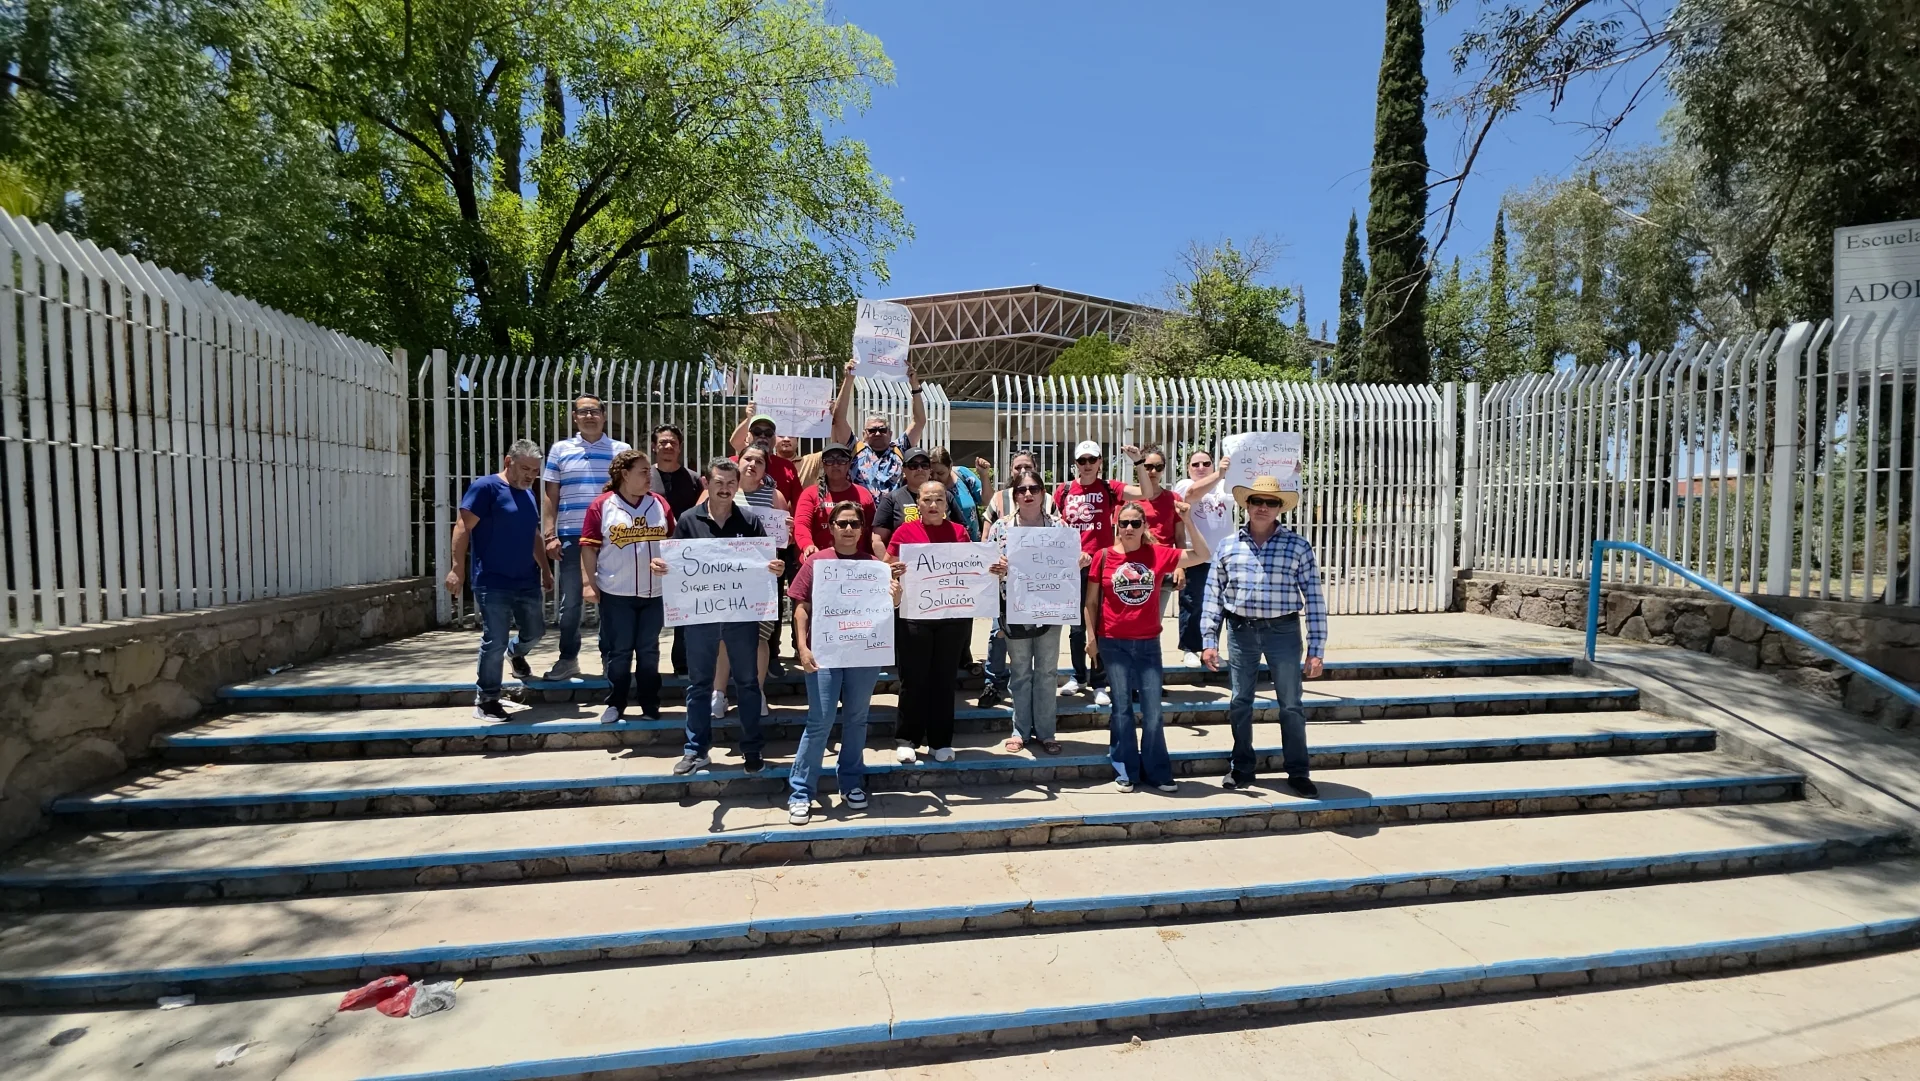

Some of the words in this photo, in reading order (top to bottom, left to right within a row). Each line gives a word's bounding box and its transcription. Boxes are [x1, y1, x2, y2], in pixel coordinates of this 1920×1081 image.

[861, 303, 910, 326] Abrogación
[874, 325, 906, 338] TOTAL
[872, 345, 885, 355] del
[760, 396, 799, 405] MENTISTE
[1257, 444, 1268, 452] un
[1240, 454, 1253, 464] de
[1258, 453, 1293, 467] Seguridad
[1244, 467, 1271, 480] Social
[634, 516, 646, 527] 60
[1096, 522, 1102, 530] 3
[1020, 535, 1038, 548] El
[682, 546, 748, 577] SONORA
[916, 553, 985, 575] Abrogación
[1032, 552, 1043, 563] El
[1046, 555, 1065, 566] Paro
[823, 566, 839, 580] Si
[846, 568, 878, 580] Puedes
[713, 583, 726, 591] EN
[732, 582, 743, 590] LA
[938, 578, 950, 586] es
[955, 576, 965, 586] la
[840, 584, 863, 594] Leer
[1027, 582, 1061, 592] ESTADO
[918, 589, 976, 610] Solución
[695, 596, 748, 615] LUCHA
[865, 607, 880, 615] que
[1013, 601, 1026, 612] No
[822, 632, 834, 643] Te
